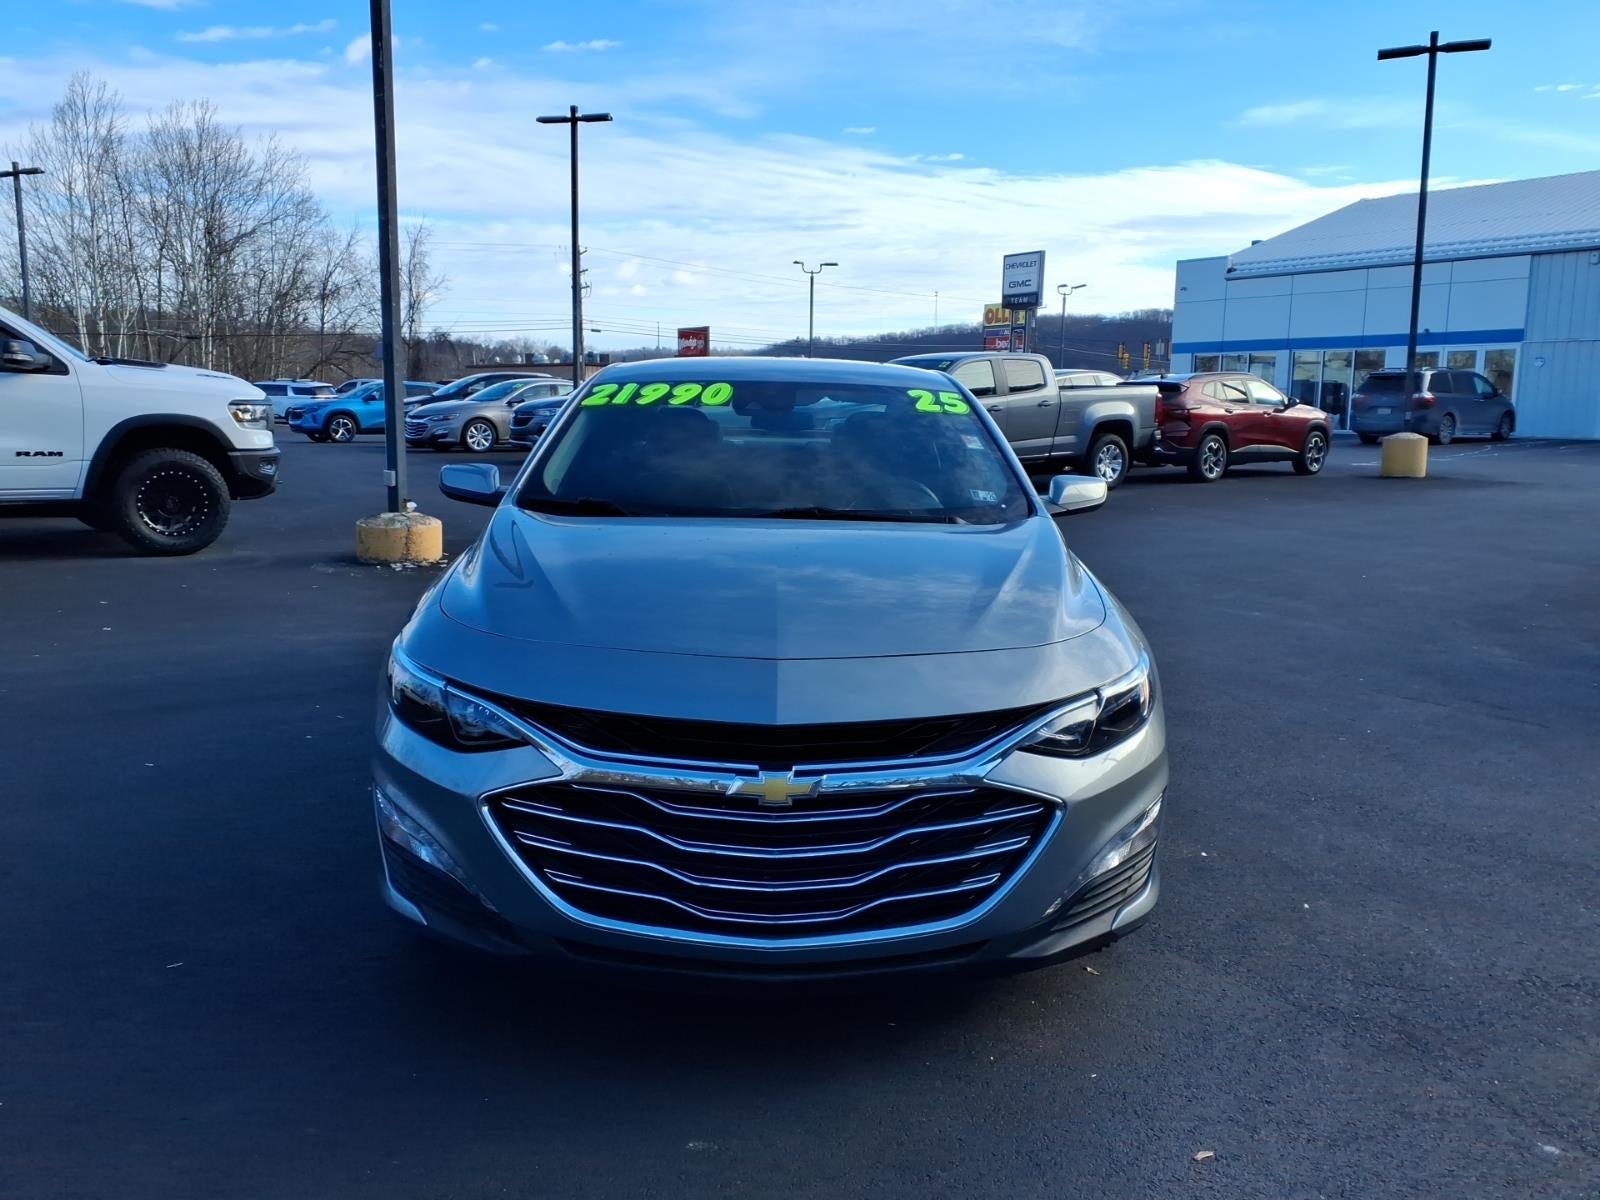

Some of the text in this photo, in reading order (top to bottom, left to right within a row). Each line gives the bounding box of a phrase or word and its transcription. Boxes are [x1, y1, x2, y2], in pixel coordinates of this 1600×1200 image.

[1006, 260, 1037, 270] CHEVROLET
[1009, 279, 1032, 289] GMC
[581, 383, 734, 406] 21990
[908, 390, 969, 414] 25
